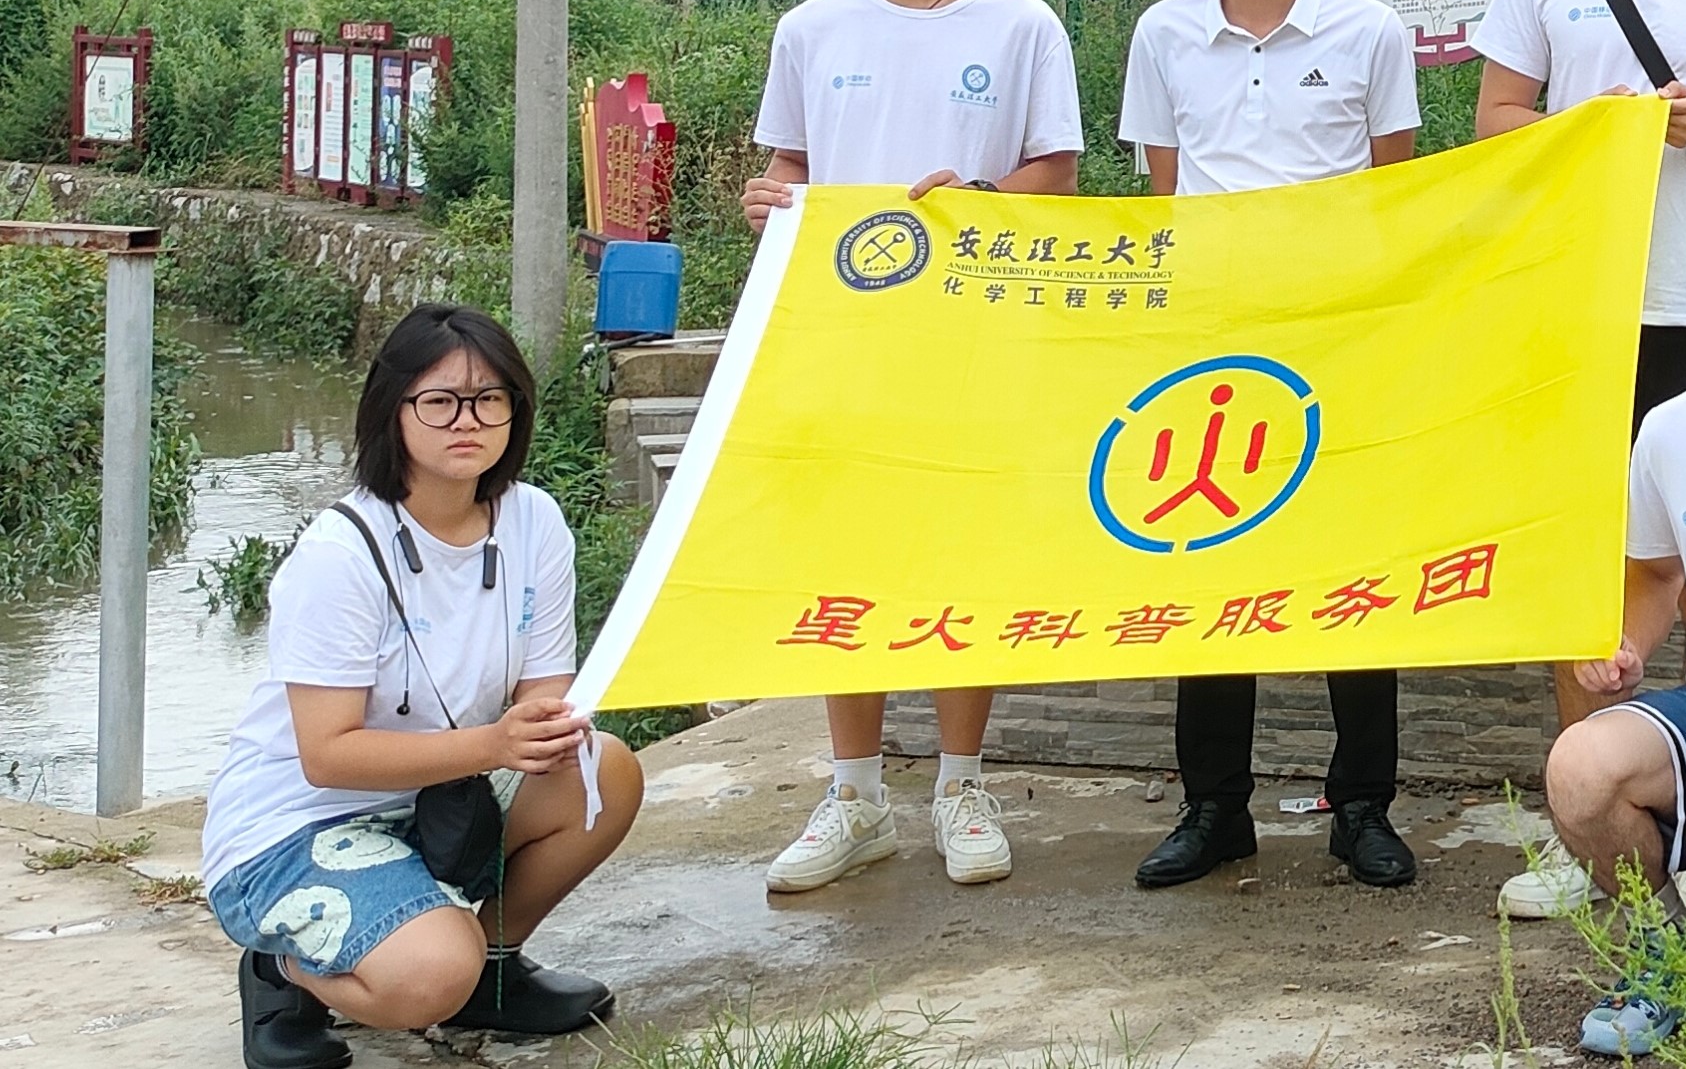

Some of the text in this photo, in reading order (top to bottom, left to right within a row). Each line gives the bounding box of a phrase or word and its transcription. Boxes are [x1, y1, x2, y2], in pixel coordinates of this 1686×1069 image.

[1299, 79, 1329, 87] adidas
[946, 261, 1175, 280] ANHUI UNIVERSITY OF SCIENCE & TECHNOLOGY
[943, 276, 1169, 310] 化学工程学院
[775, 543, 1499, 652] 星火科普服务团
